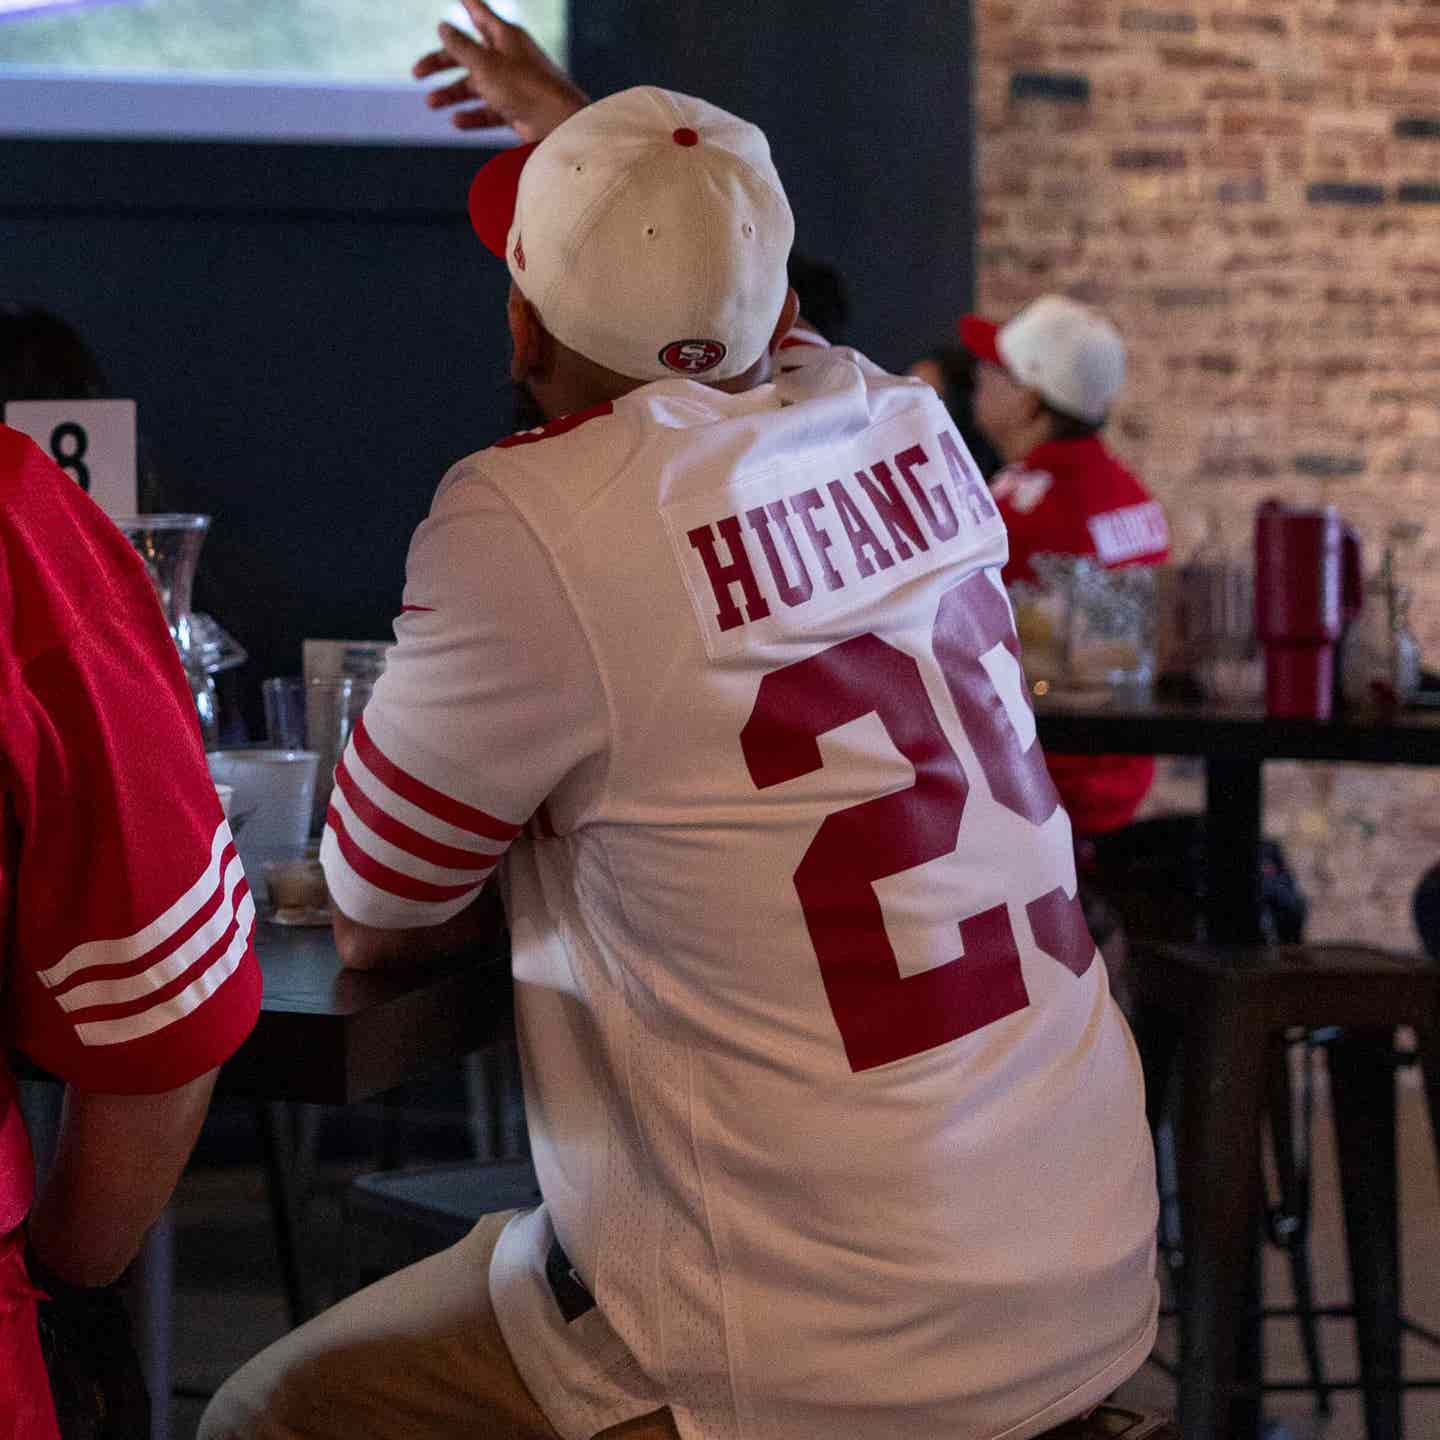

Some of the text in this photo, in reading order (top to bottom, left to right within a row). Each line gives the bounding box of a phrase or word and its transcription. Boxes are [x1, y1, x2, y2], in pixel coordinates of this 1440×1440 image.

[50, 421, 90, 493] 8
[687, 430, 997, 633] HUFANGA
[740, 567, 1096, 1073] 29
